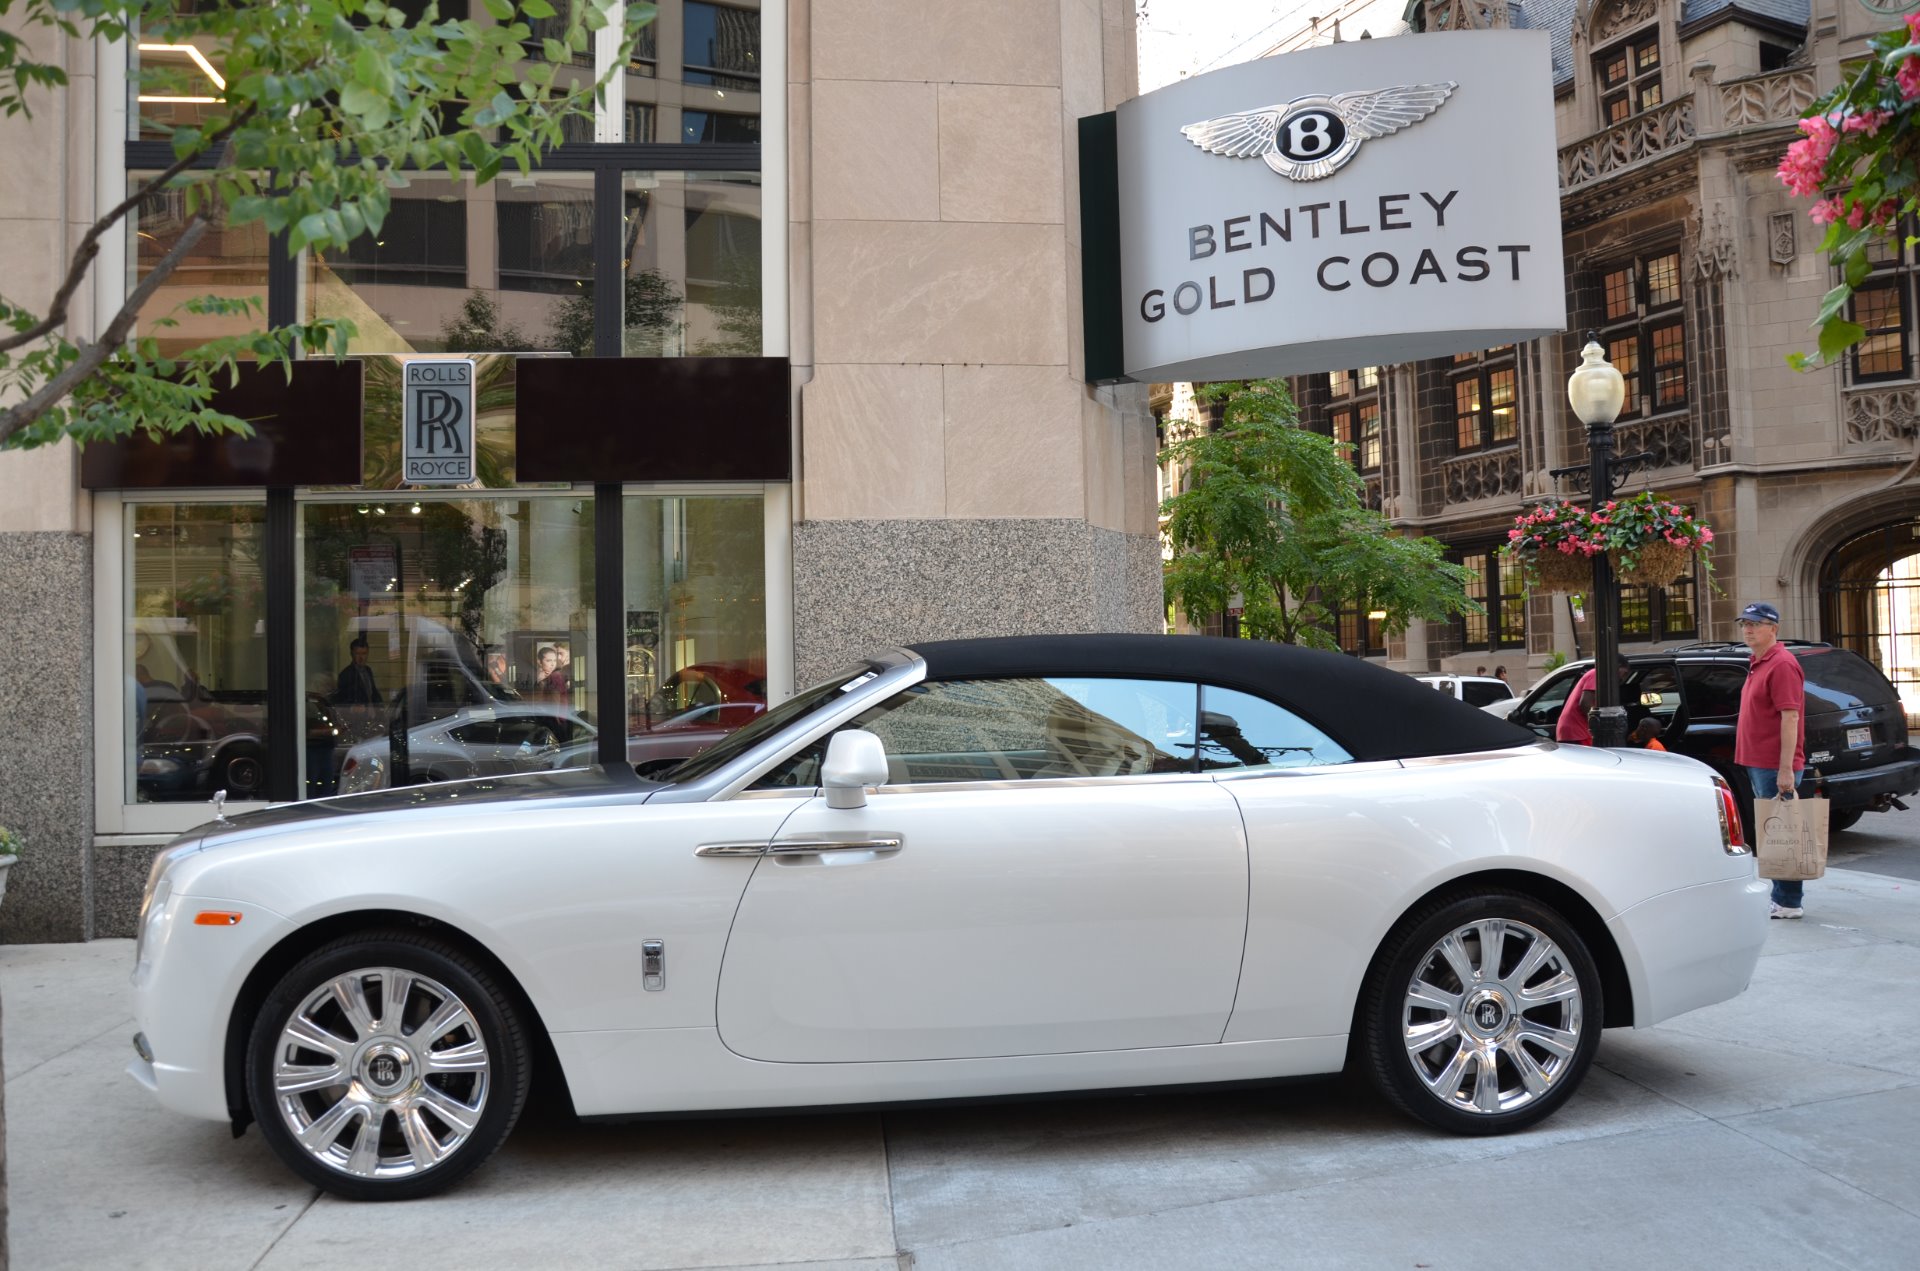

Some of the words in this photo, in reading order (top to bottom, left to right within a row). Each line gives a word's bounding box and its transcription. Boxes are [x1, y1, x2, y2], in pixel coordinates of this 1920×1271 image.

[1188, 190, 1459, 261] BENTLEY
[1140, 267, 1276, 323] GOLD
[1316, 245, 1531, 292] COAST
[411, 368, 467, 381] ROLLS
[410, 461, 466, 475] ROYCE
